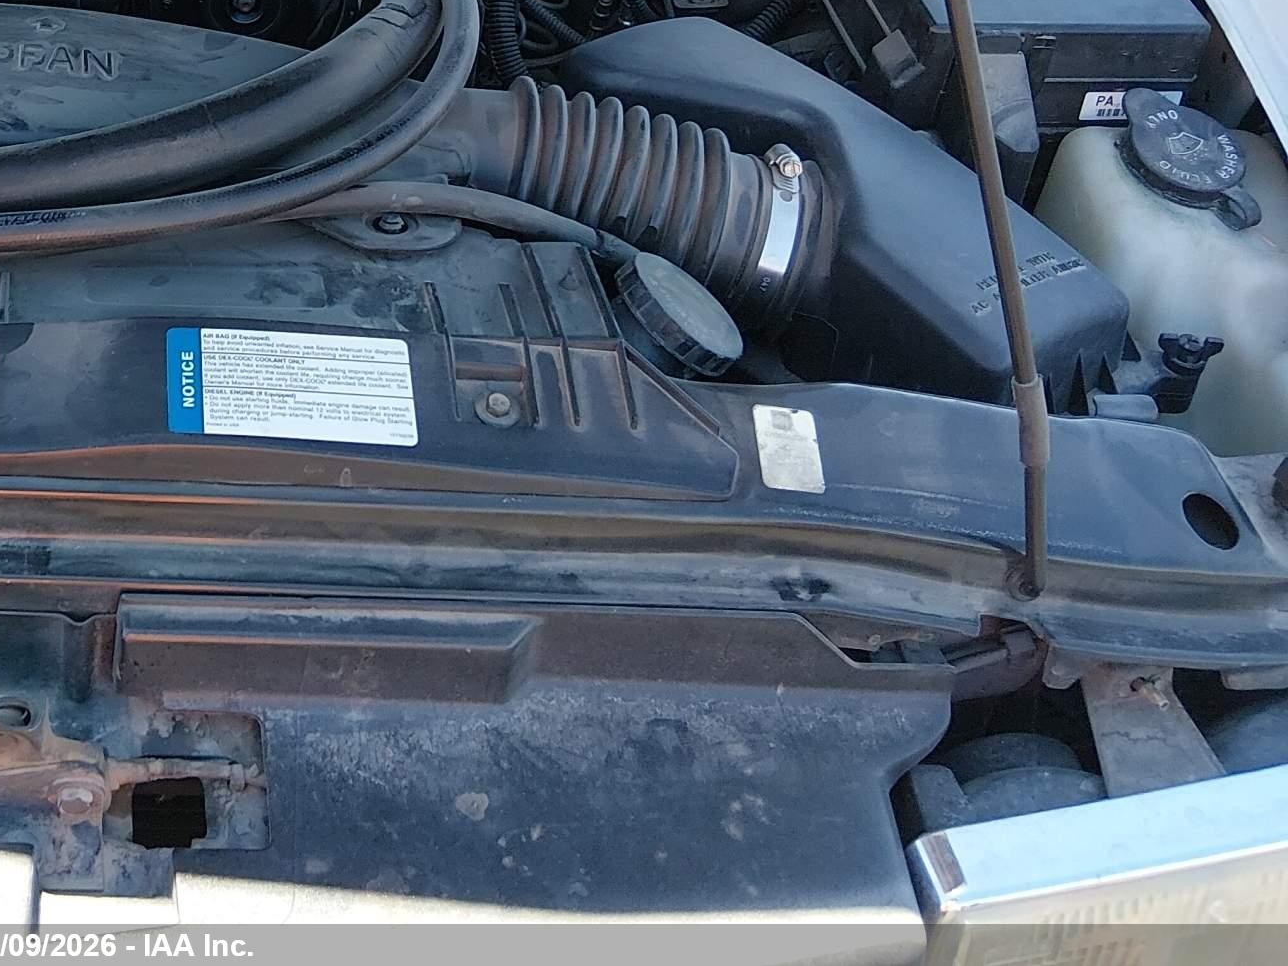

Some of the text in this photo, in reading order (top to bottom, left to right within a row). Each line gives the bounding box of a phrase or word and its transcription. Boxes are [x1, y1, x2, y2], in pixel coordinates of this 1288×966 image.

[1096, 96, 1113, 107] PA
[1144, 109, 1178, 129] ONLY
[1216, 134, 1241, 180] WASHER
[182, 351, 194, 408] NOTICE
